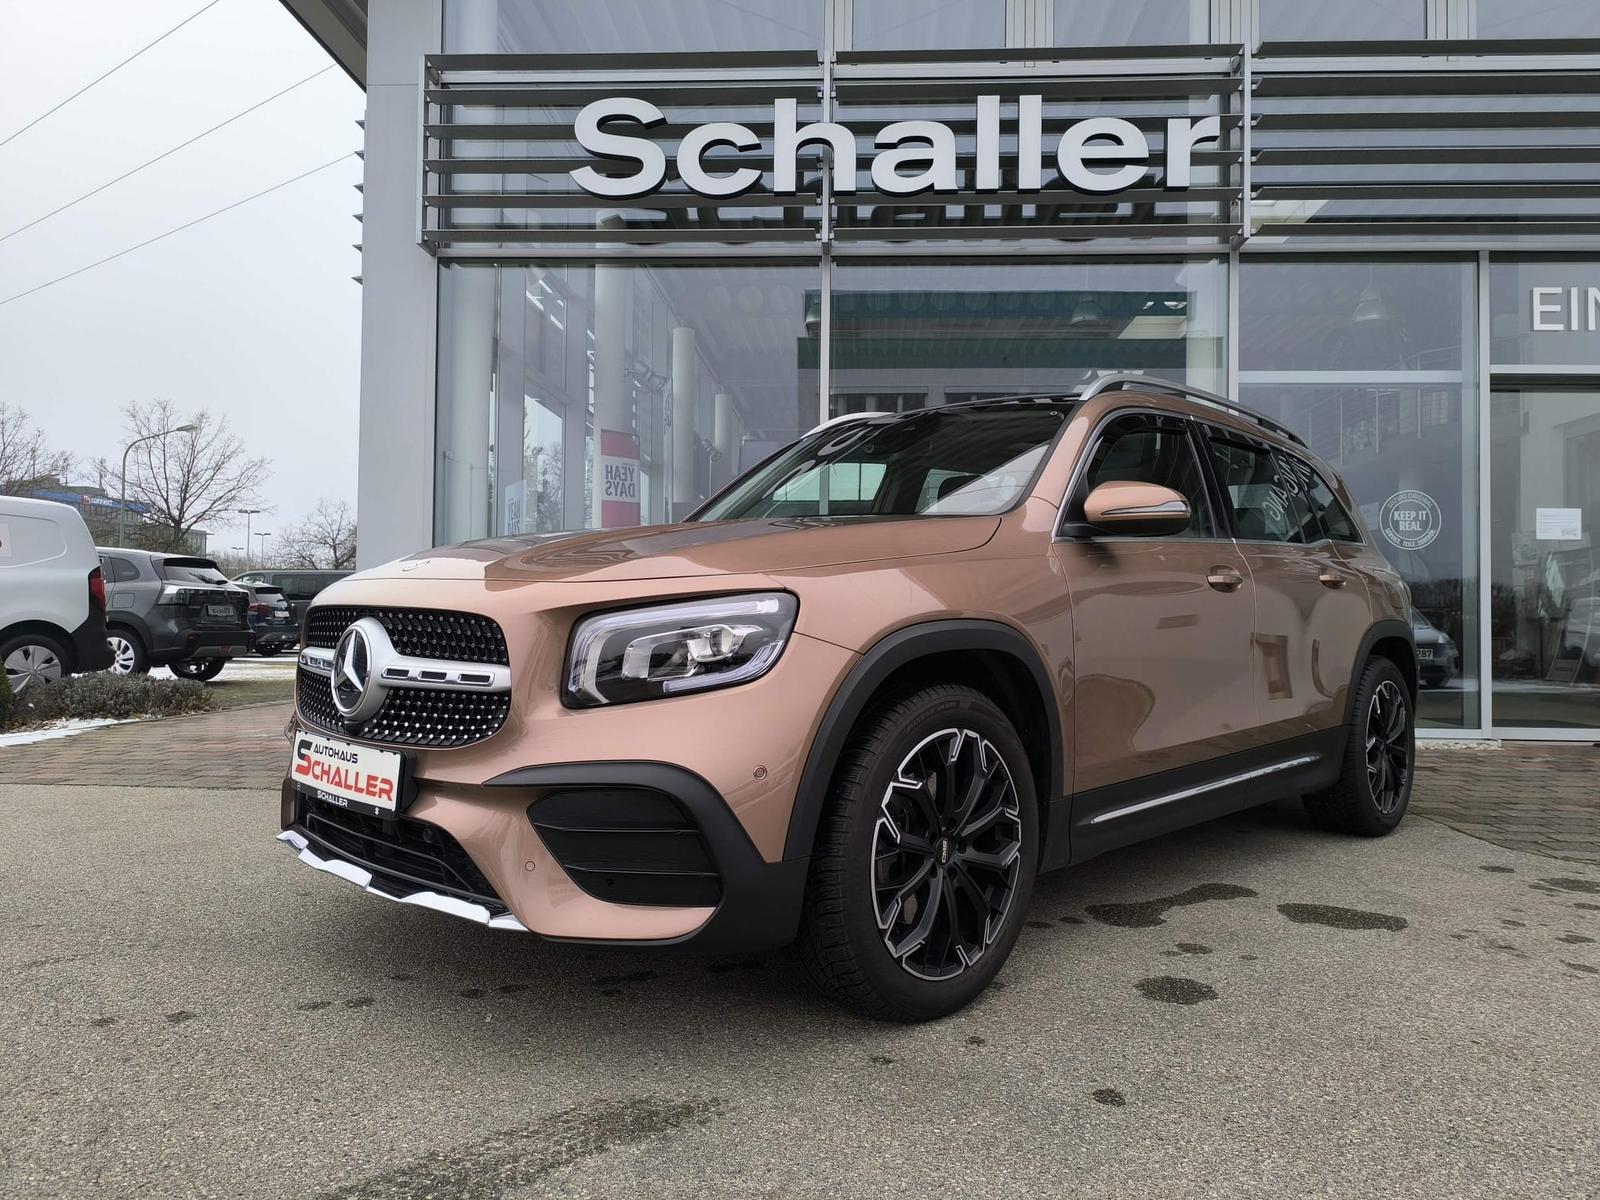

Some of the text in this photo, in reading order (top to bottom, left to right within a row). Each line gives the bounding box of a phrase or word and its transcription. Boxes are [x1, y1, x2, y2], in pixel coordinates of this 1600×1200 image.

[570, 94, 1221, 199] Schaller
[1394, 510, 1427, 521] KEEP IT
[1400, 521, 1422, 531] REAL
[314, 744, 358, 764] AUTOHAUS
[295, 739, 394, 802] SCHALLER
[317, 789, 348, 808] SCHALLER
